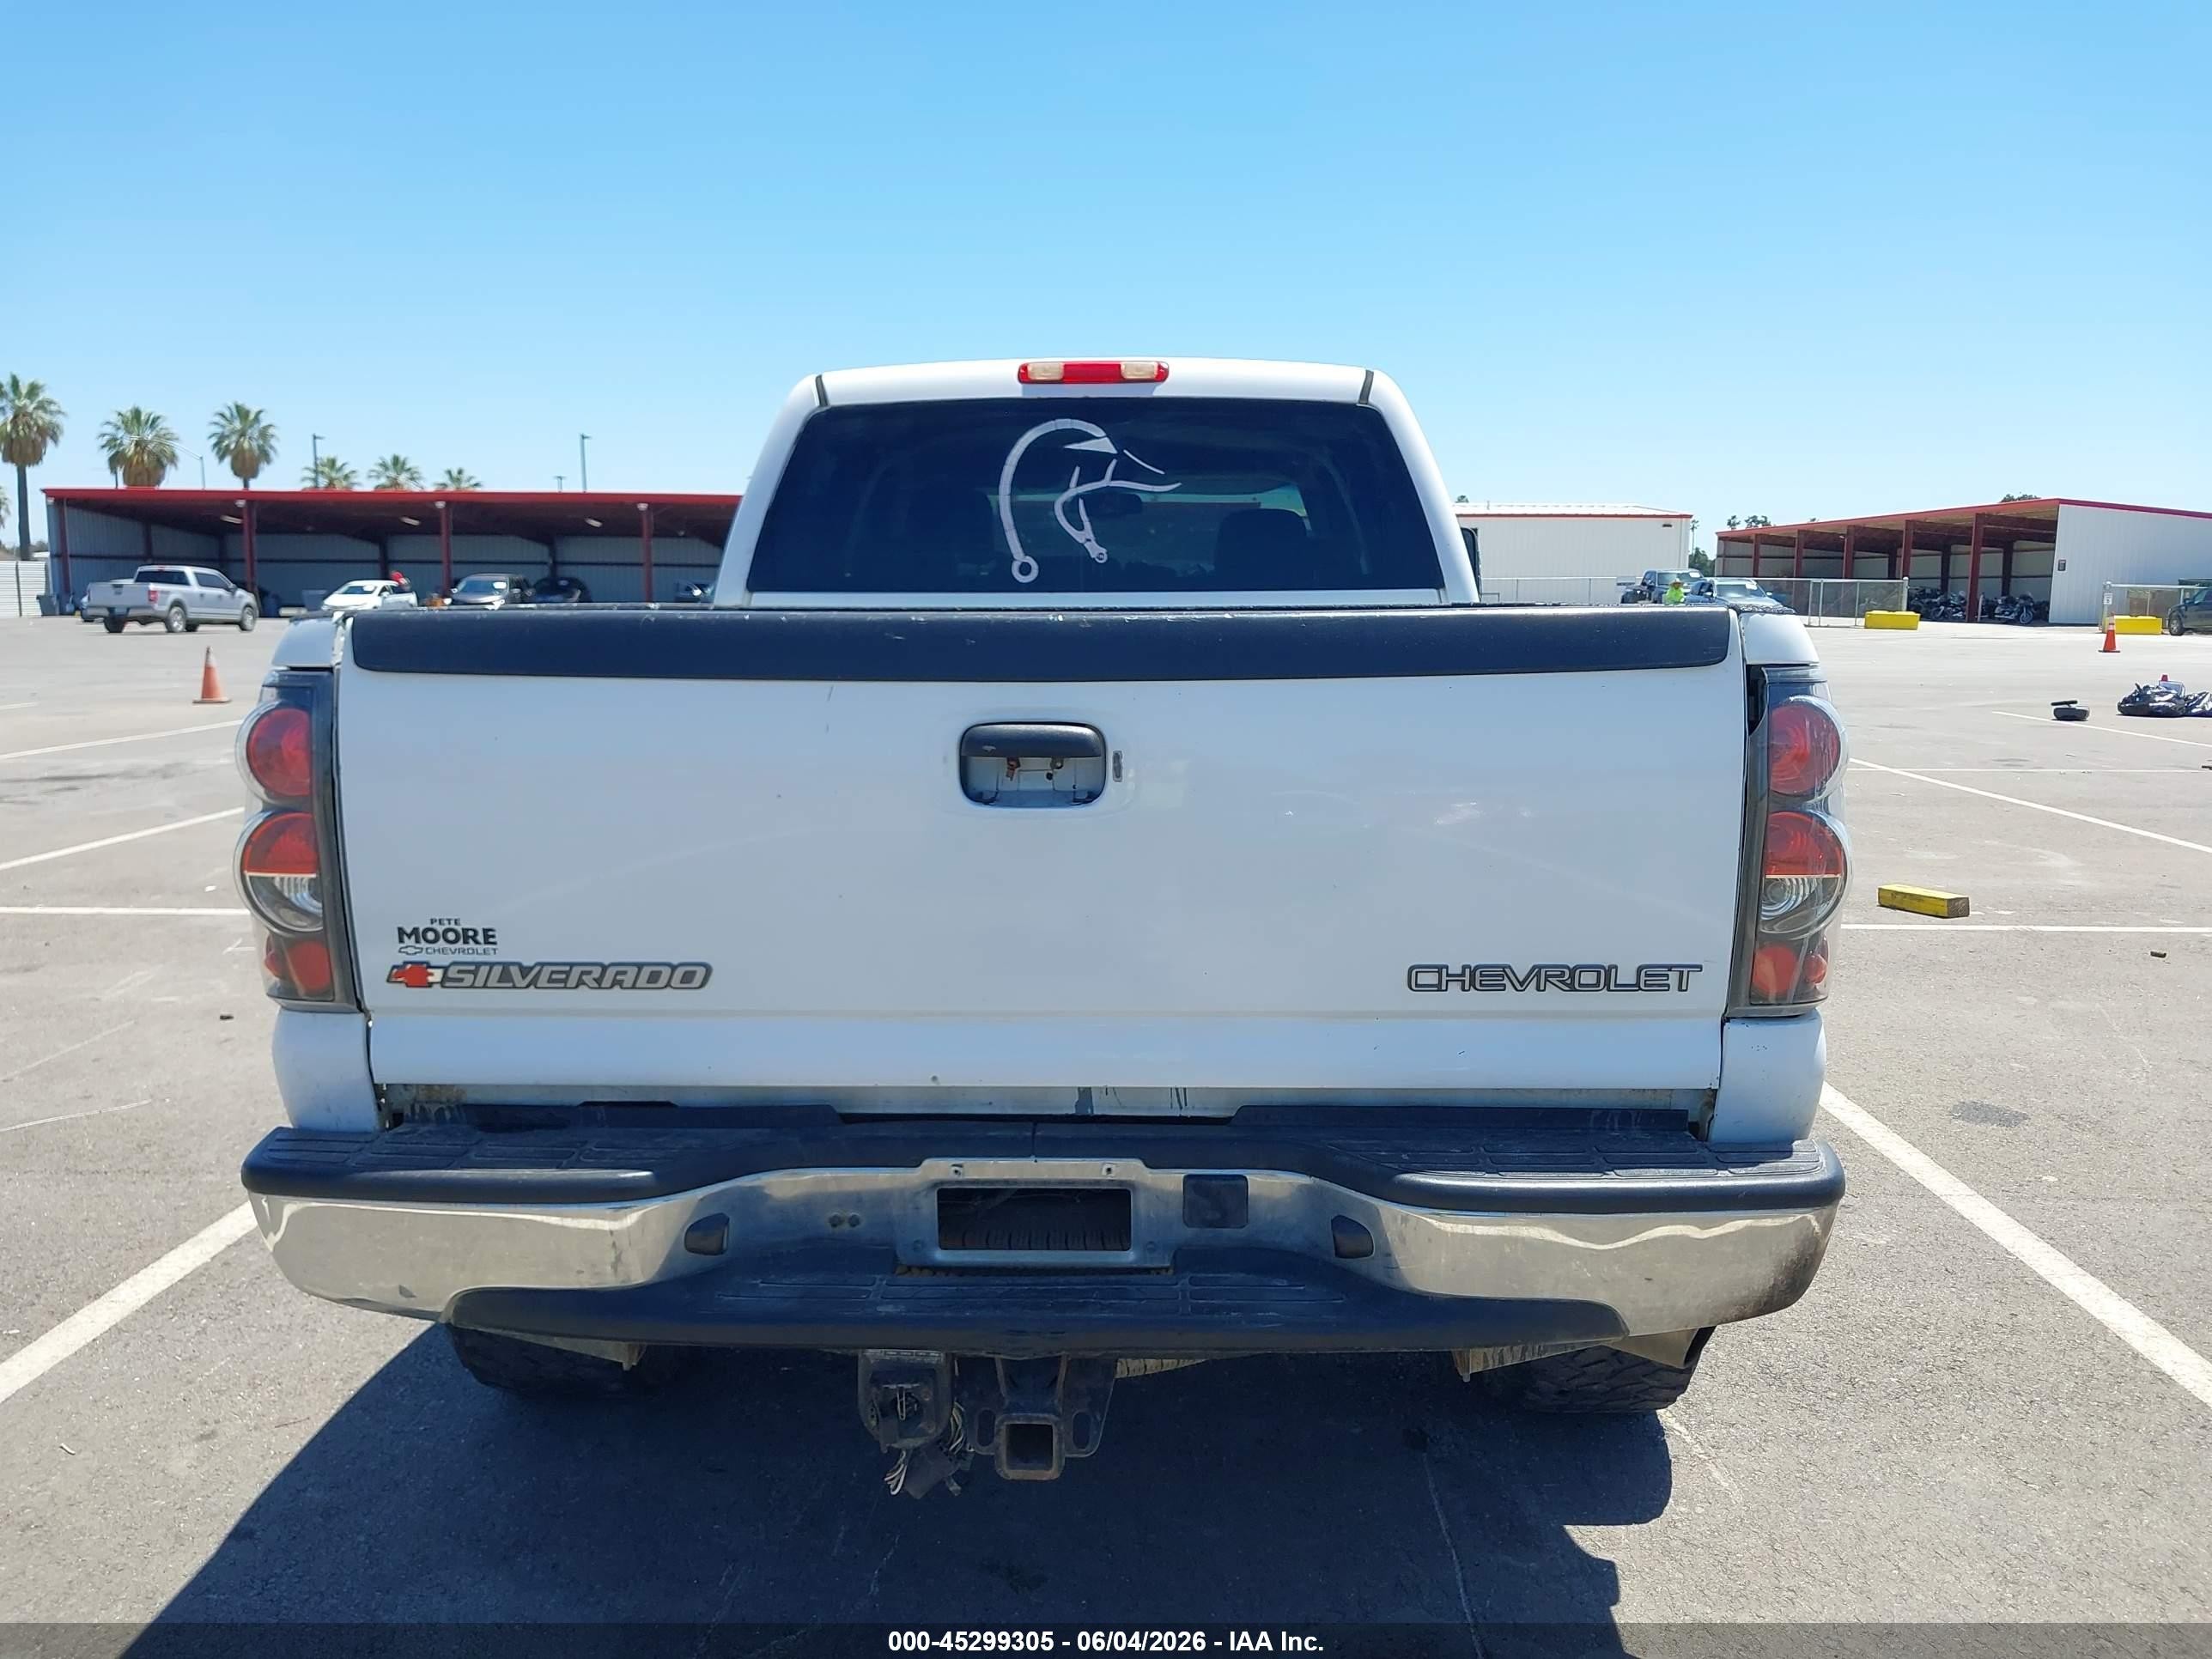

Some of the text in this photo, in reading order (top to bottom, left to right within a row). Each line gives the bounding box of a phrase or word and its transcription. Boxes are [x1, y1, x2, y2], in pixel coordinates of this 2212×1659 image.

[397, 927, 498, 945] MOORE
[425, 946, 499, 956] CHEVROLET
[441, 963, 712, 989] SILVERADO
[1407, 963, 1704, 992] CHEVROLET
